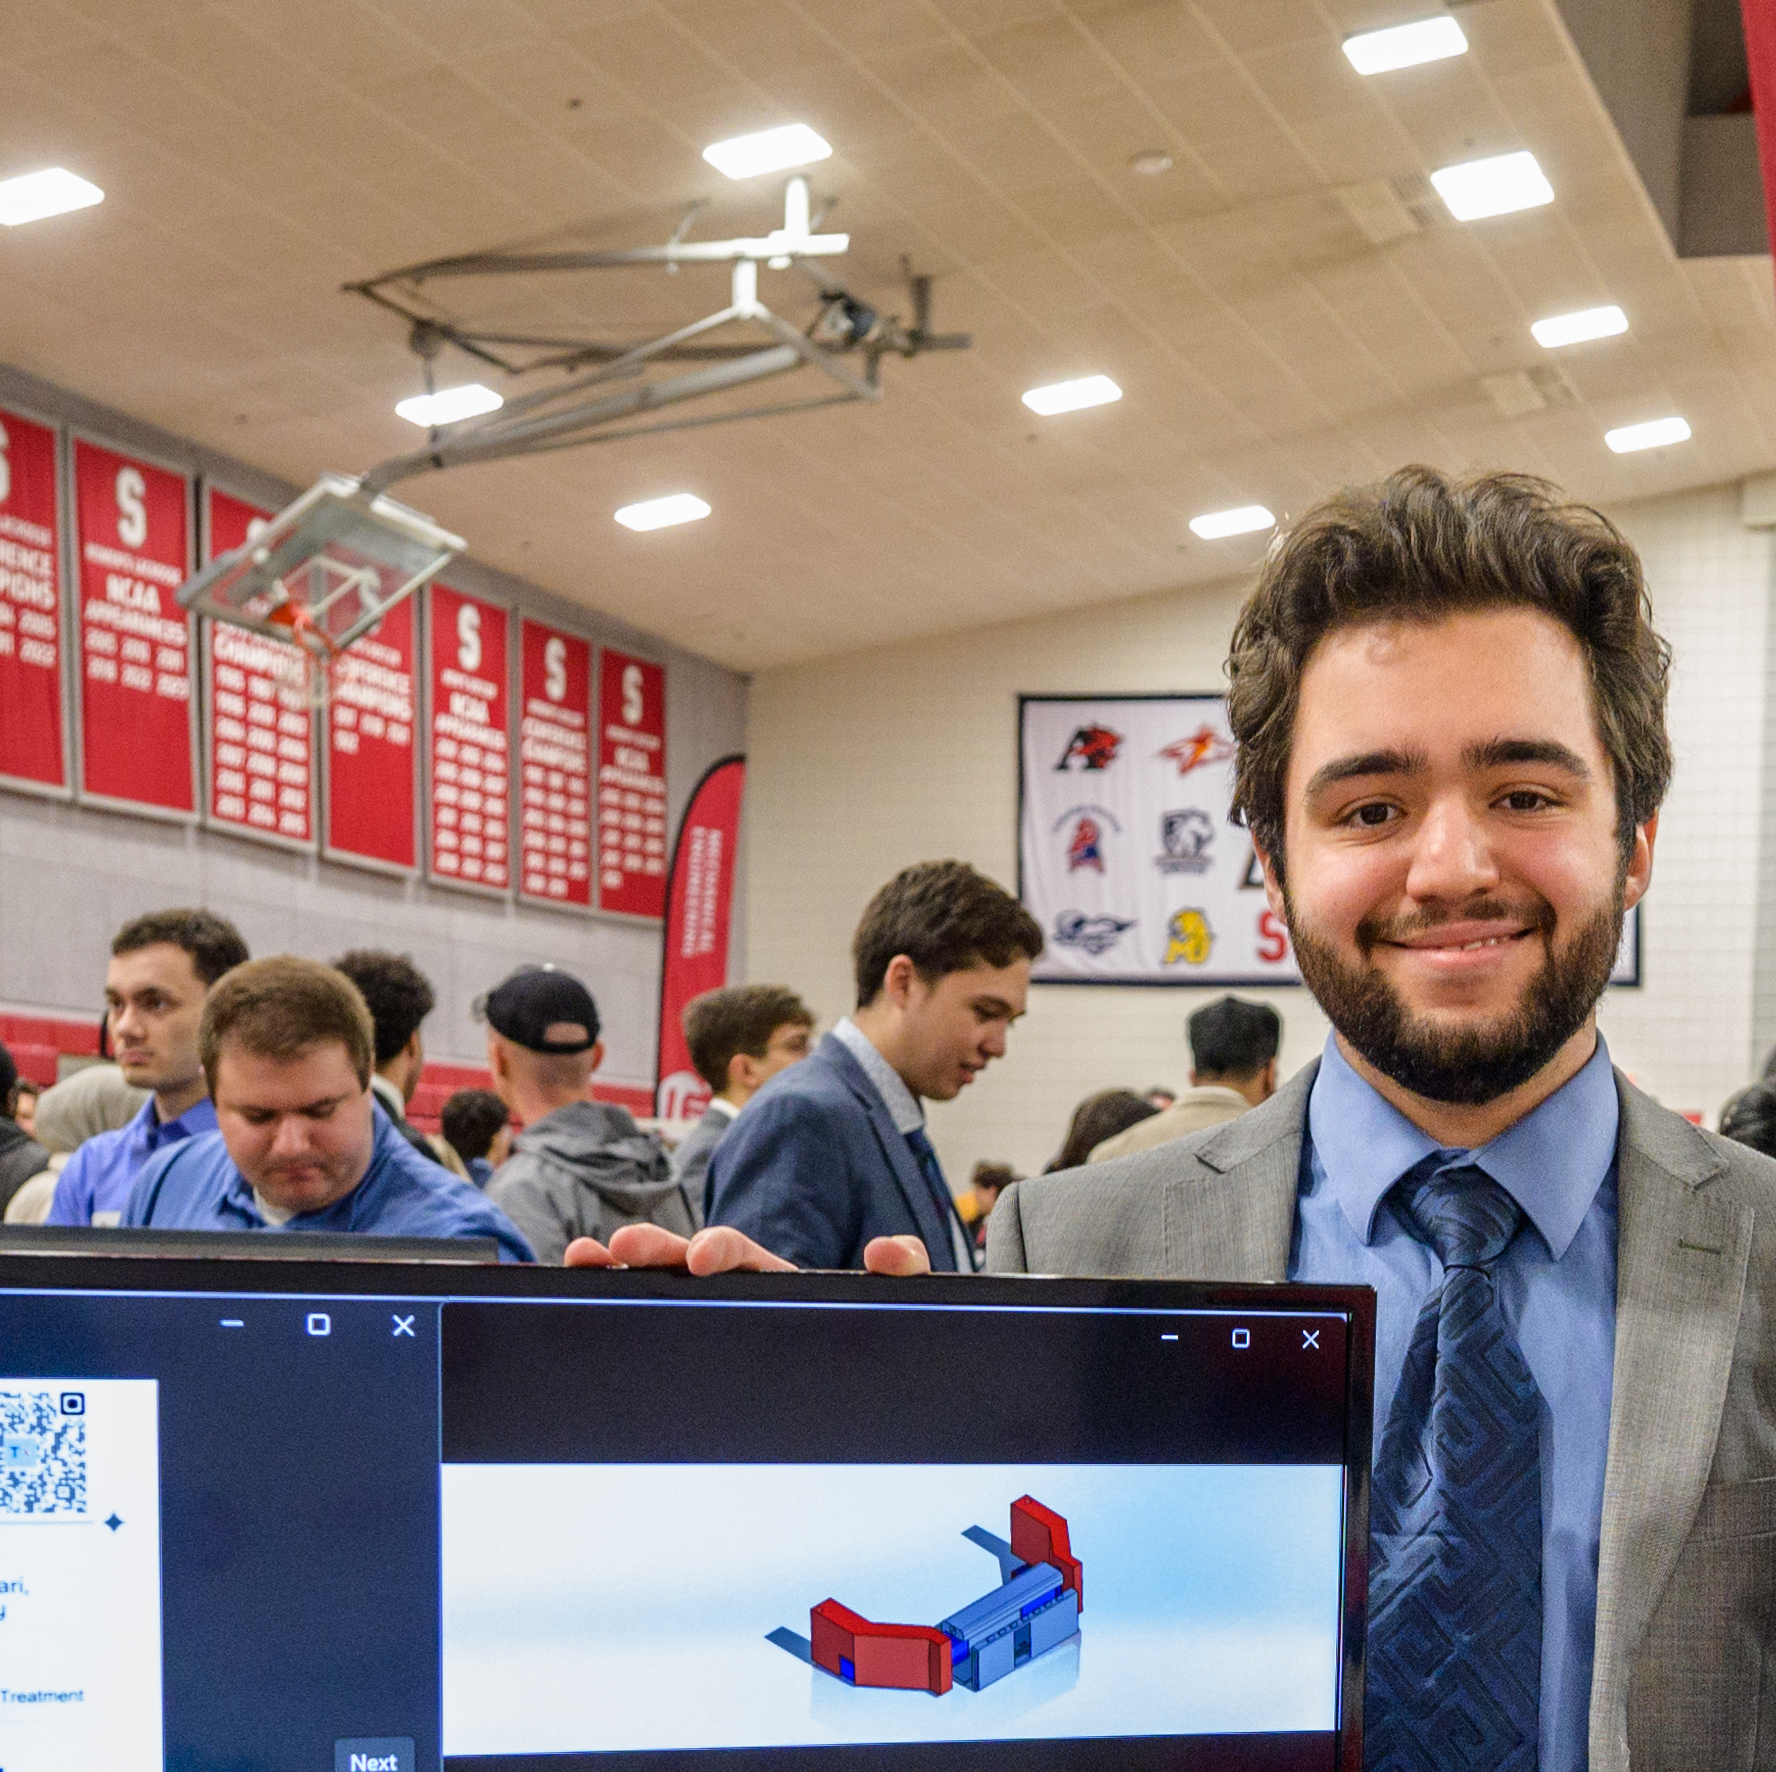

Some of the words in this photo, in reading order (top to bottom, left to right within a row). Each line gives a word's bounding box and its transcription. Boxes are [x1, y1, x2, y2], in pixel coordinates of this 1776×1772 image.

[115, 466, 148, 548] S
[455, 602, 482, 673] S
[544, 636, 568, 701] S
[621, 664, 645, 725] S
[0, 1687, 86, 1705] Treatment
[349, 1752, 398, 1772] Next
